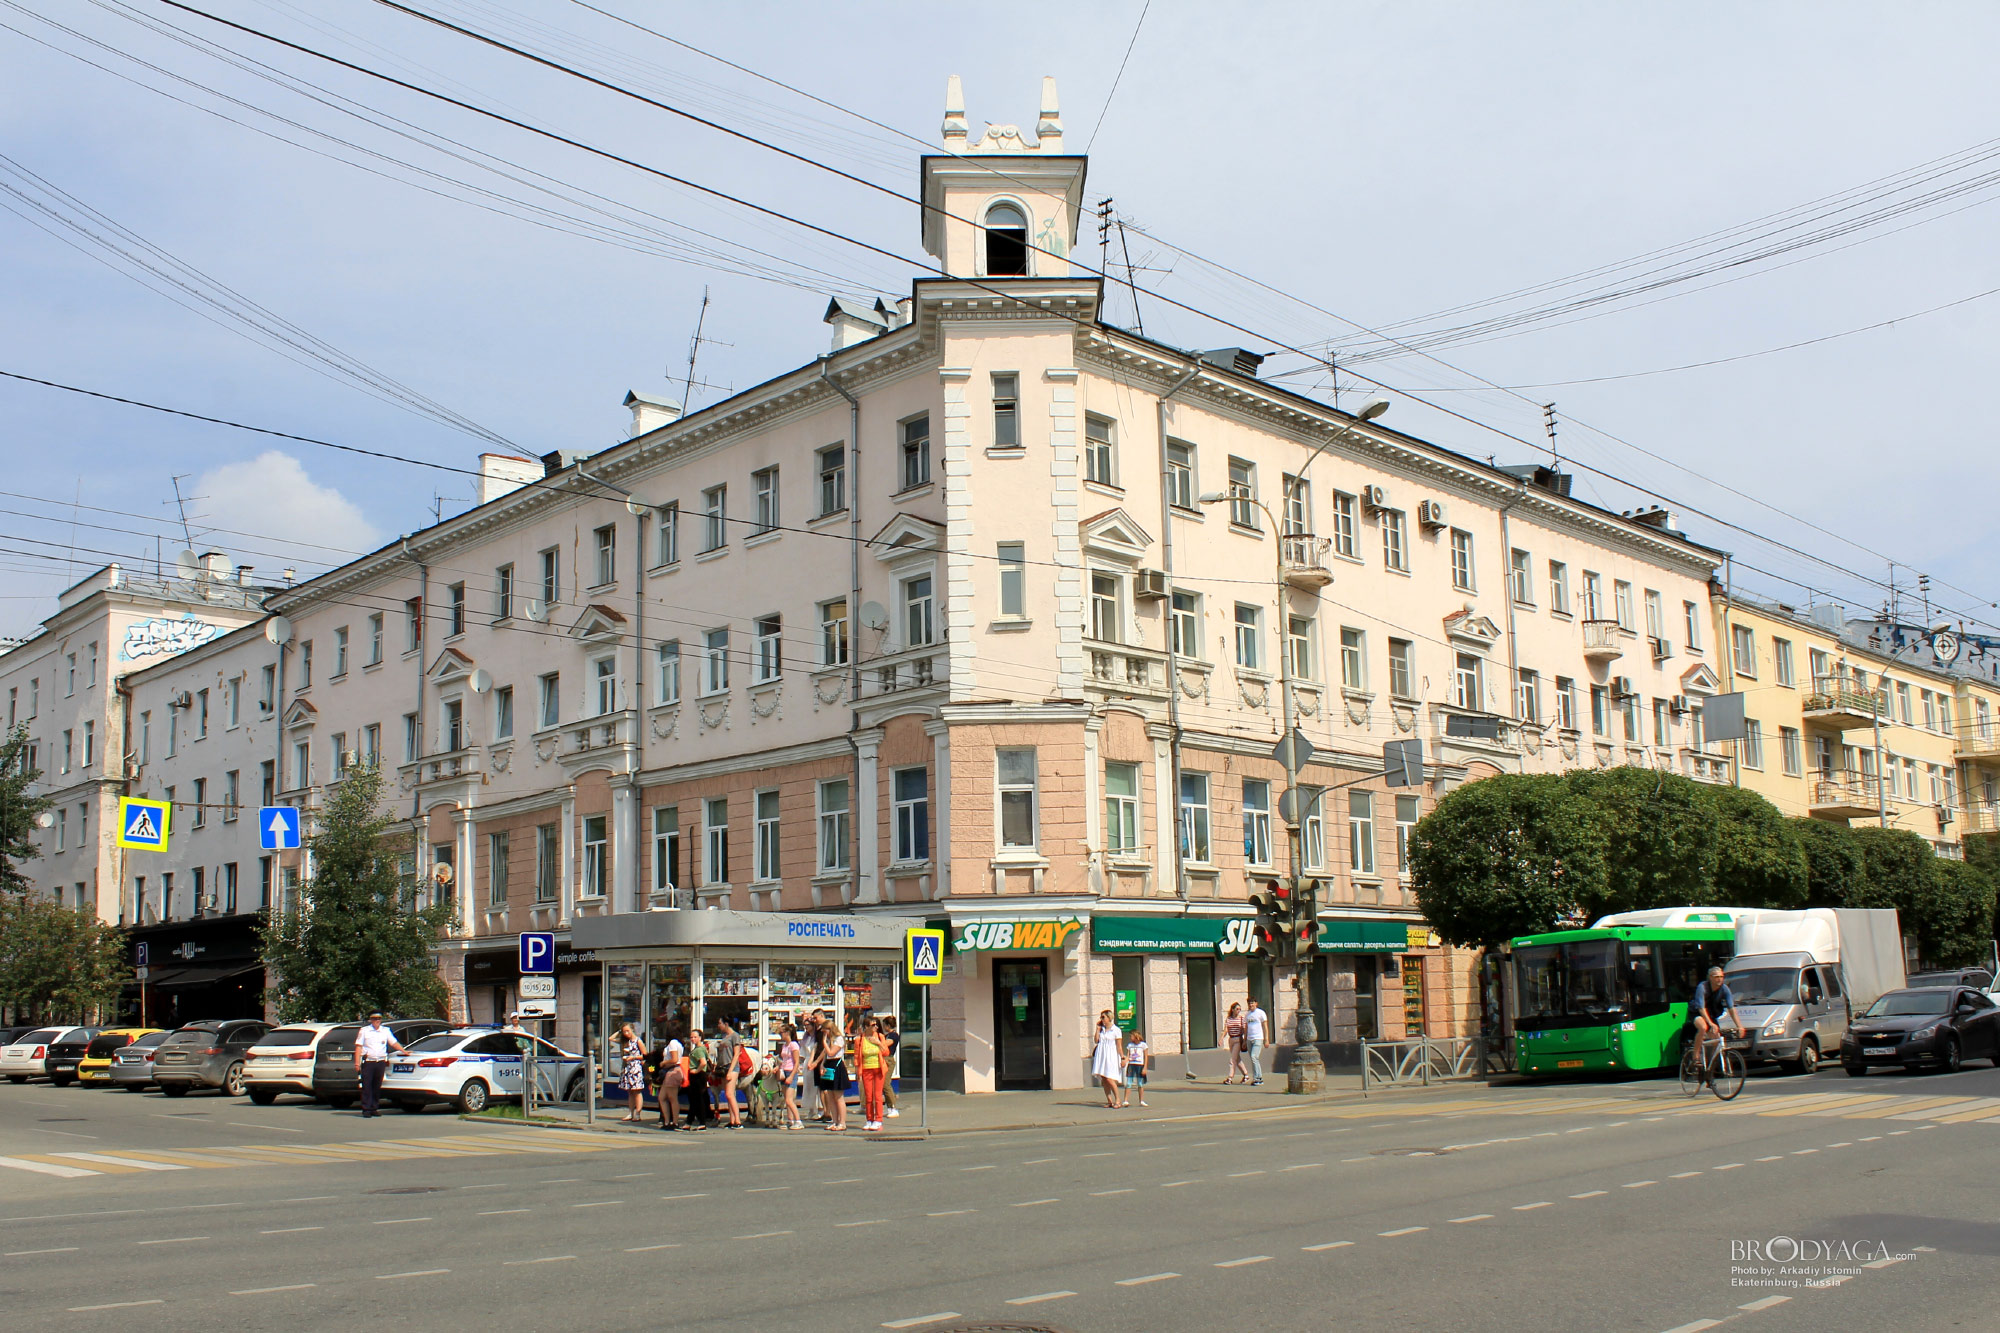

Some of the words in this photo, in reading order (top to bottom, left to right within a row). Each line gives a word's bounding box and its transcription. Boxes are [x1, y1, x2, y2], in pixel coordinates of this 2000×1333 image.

[788, 922, 855, 938] РОСПЕЧАТЬ
[954, 922, 1081, 951] SUBWAY
[1098, 939, 1132, 948] сэндвичи
[1133, 940, 1159, 948] салаты
[1188, 940, 1214, 948] напитки
[528, 937, 547, 969] P
[557, 952, 578, 966] simple
[532, 983, 540, 991] 15
[541, 983, 551, 992] 20
[498, 1069, 520, 1077] 1-916
